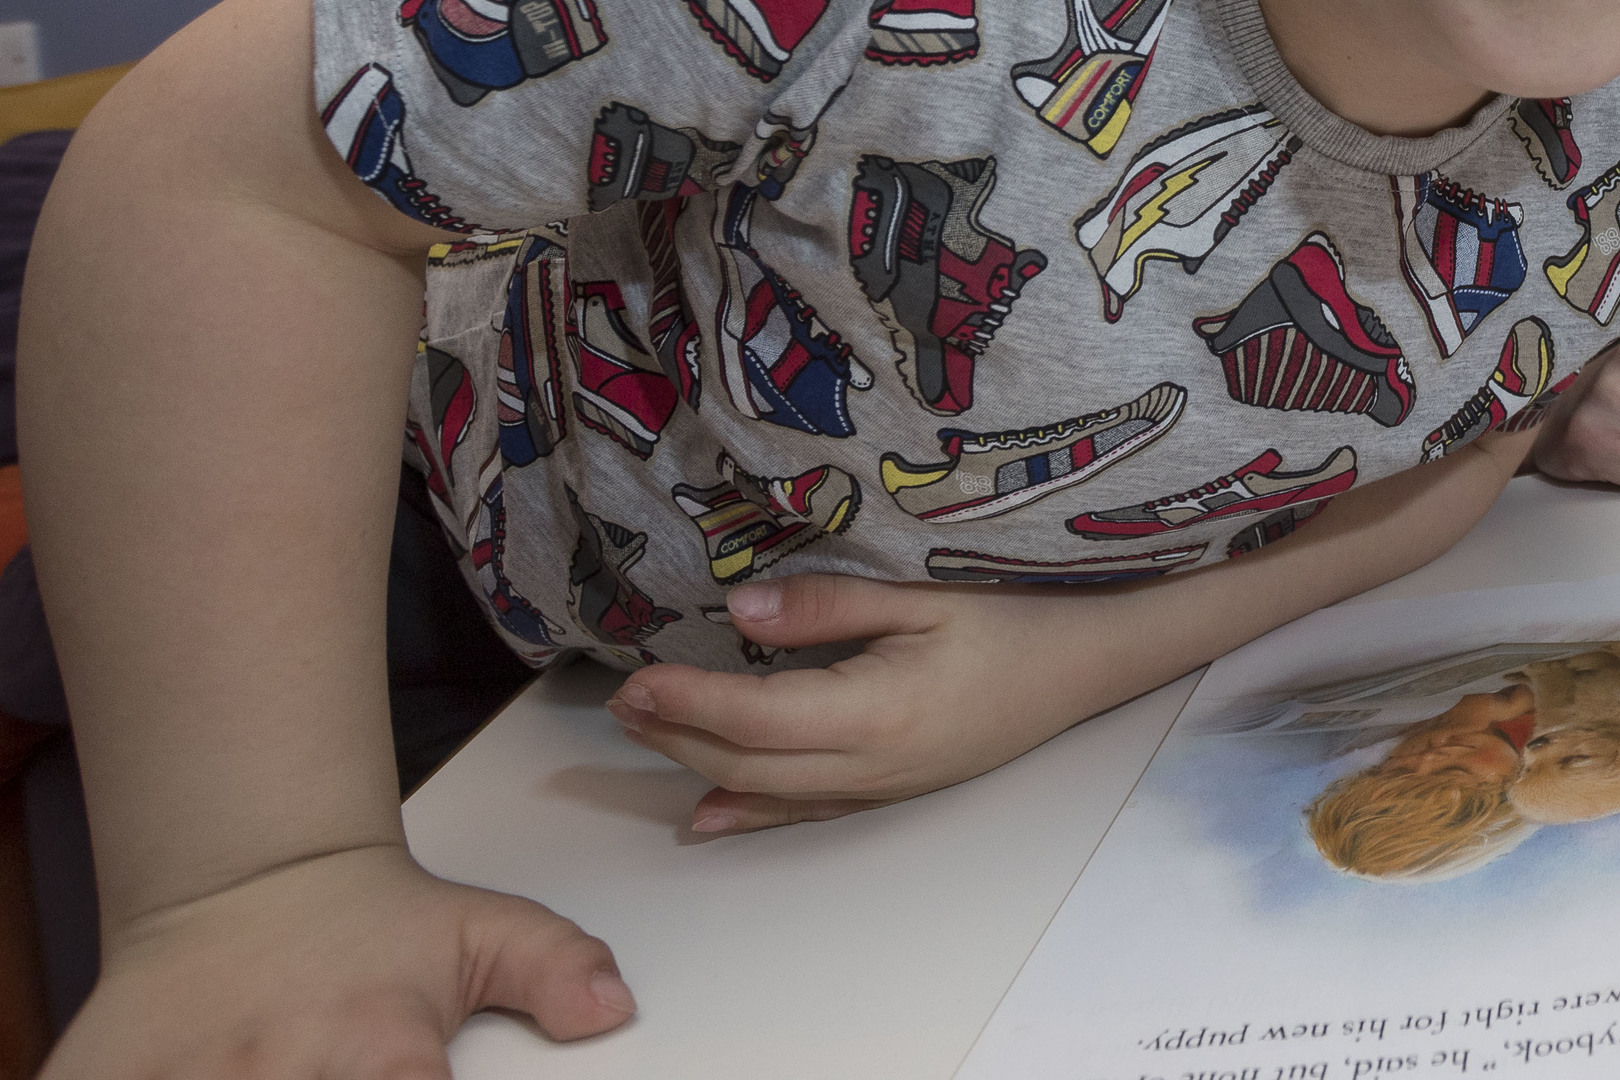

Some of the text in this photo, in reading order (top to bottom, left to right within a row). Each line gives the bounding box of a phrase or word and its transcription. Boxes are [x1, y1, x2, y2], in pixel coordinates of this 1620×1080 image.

[1087, 69, 1132, 128] COMFORT
[720, 524, 767, 554] COMFORT
[1399, 1010, 1447, 1036] for
[1460, 1000, 1540, 1030] right
[1136, 1023, 1250, 1051] puppy.
[1260, 1023, 1330, 1042] new
[1342, 1018, 1388, 1042] his
[1275, 1062, 1329, 1080] but
[1344, 1055, 1418, 1080] said,
[1431, 1048, 1470, 1073] he
